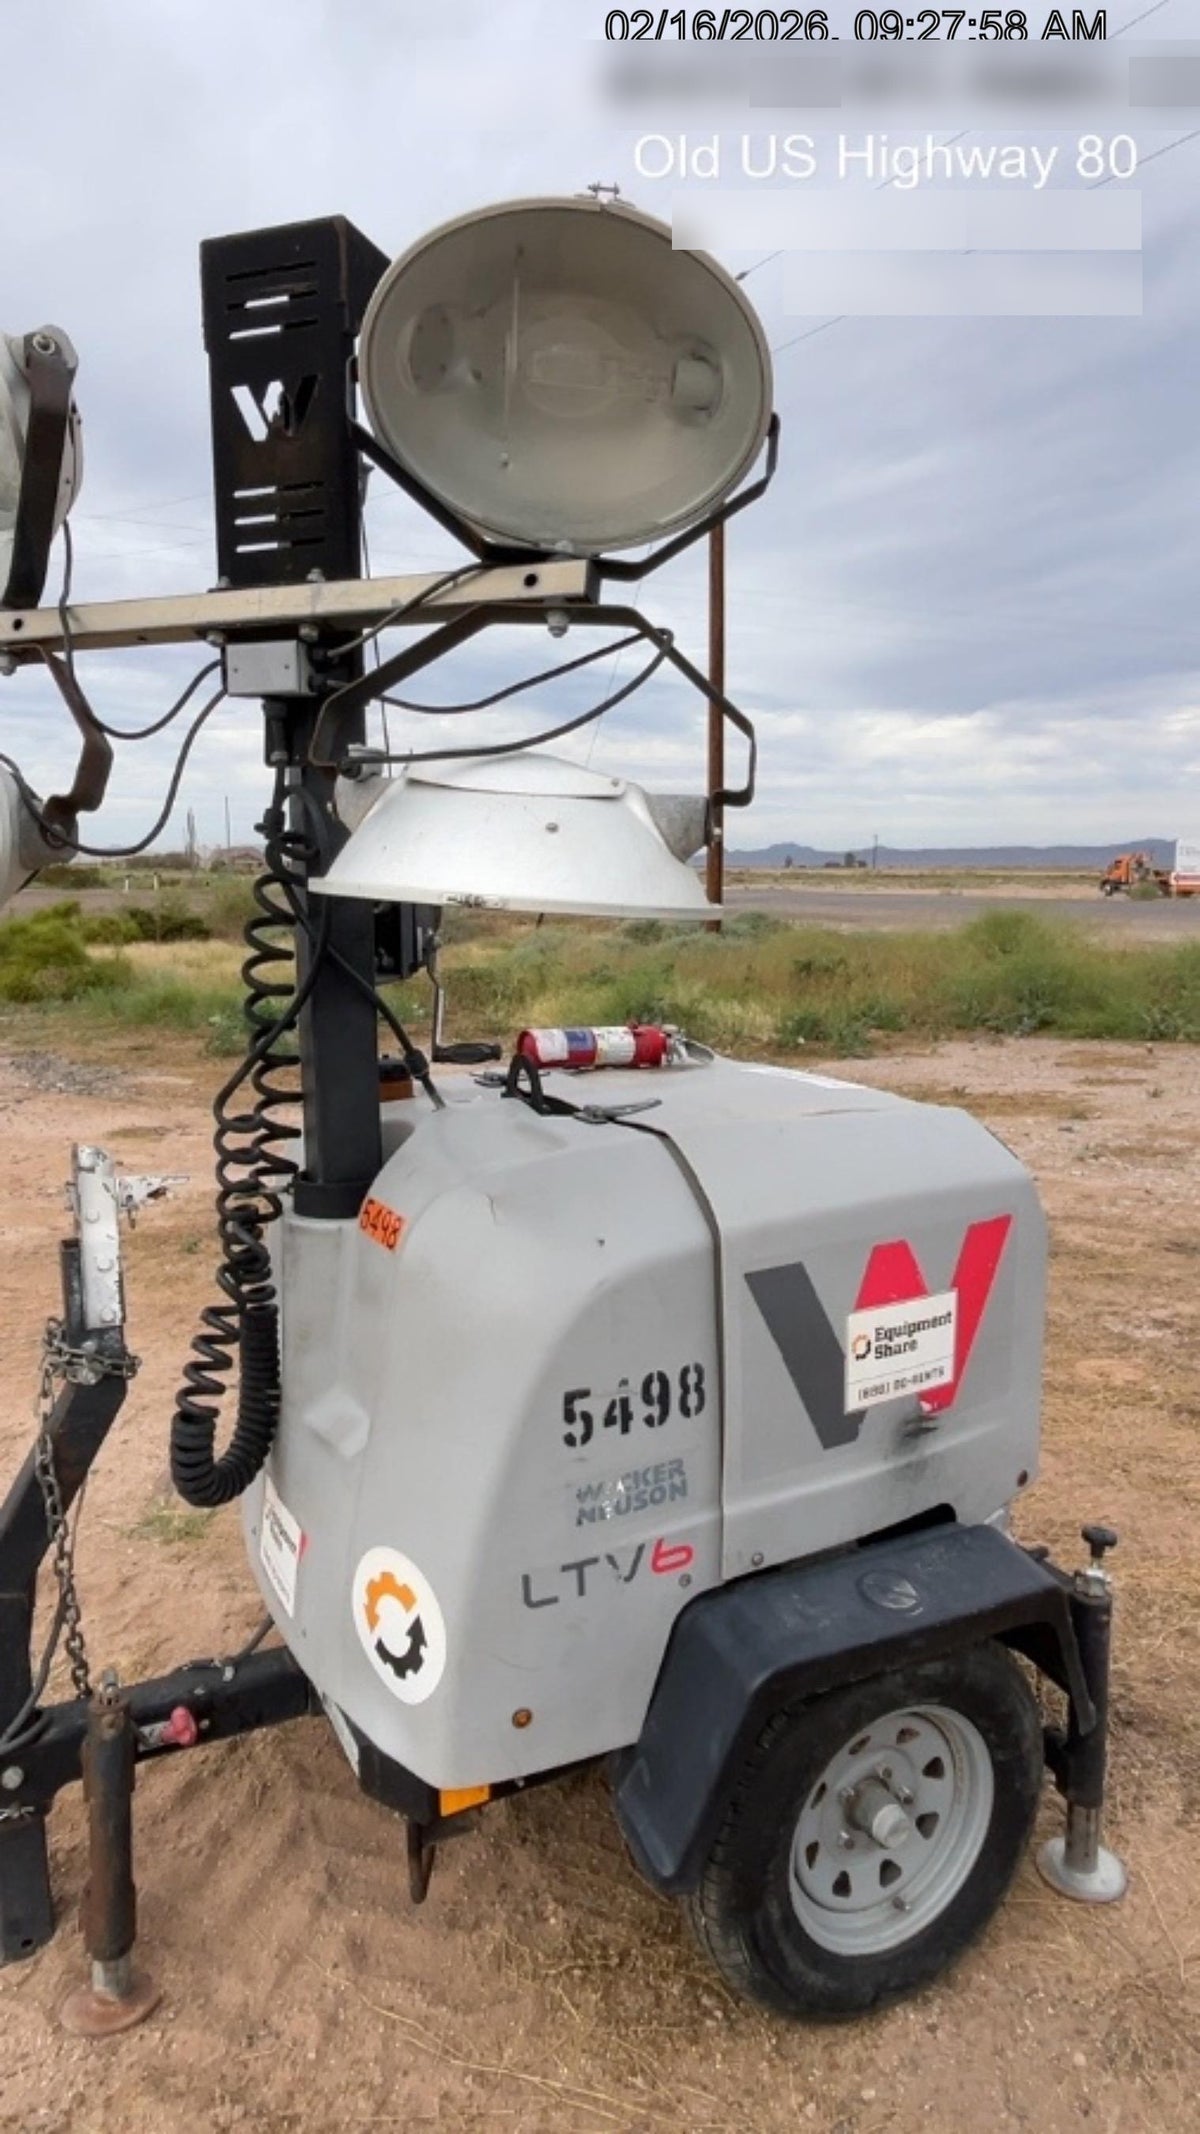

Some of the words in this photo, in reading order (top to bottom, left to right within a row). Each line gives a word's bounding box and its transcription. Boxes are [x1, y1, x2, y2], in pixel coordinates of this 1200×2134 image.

[874, 1310, 953, 1342] Equipment
[874, 1338, 919, 1360] Share
[563, 1362, 706, 1447] 5498
[575, 1457, 686, 1503] WCKER
